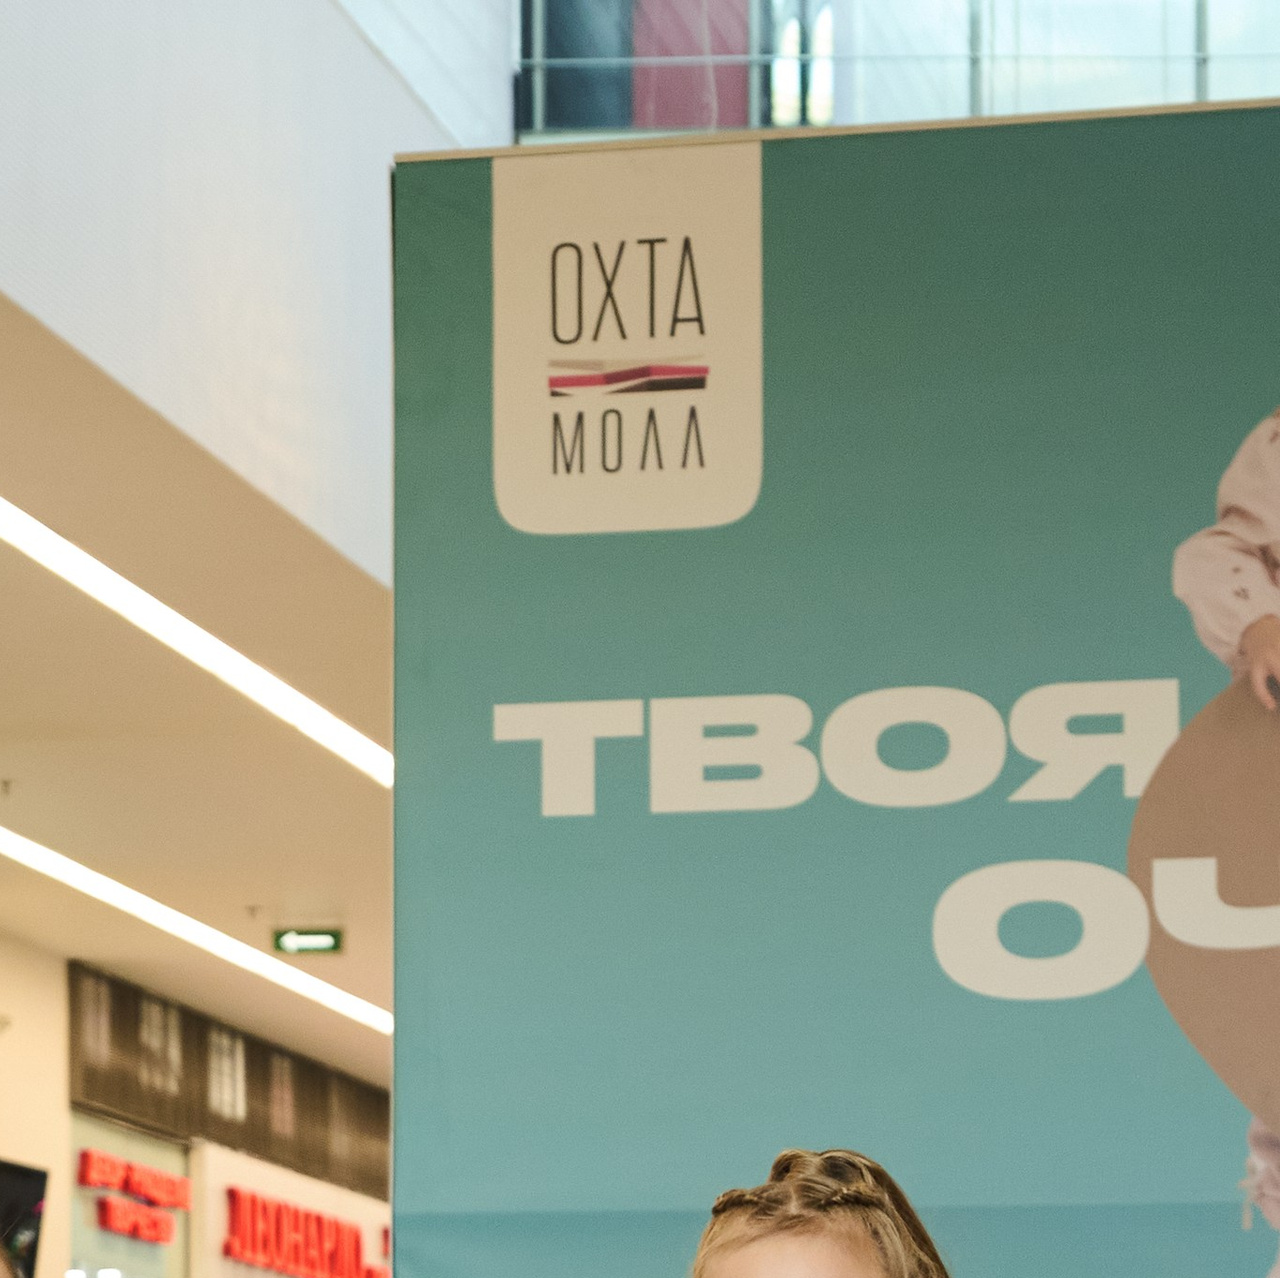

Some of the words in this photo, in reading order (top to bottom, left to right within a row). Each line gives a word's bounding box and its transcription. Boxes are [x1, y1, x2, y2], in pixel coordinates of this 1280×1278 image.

[550, 235, 706, 345] ОХТА
[552, 404, 706, 476] МОЛЛ
[492, 678, 1180, 817] ТВОЯ
